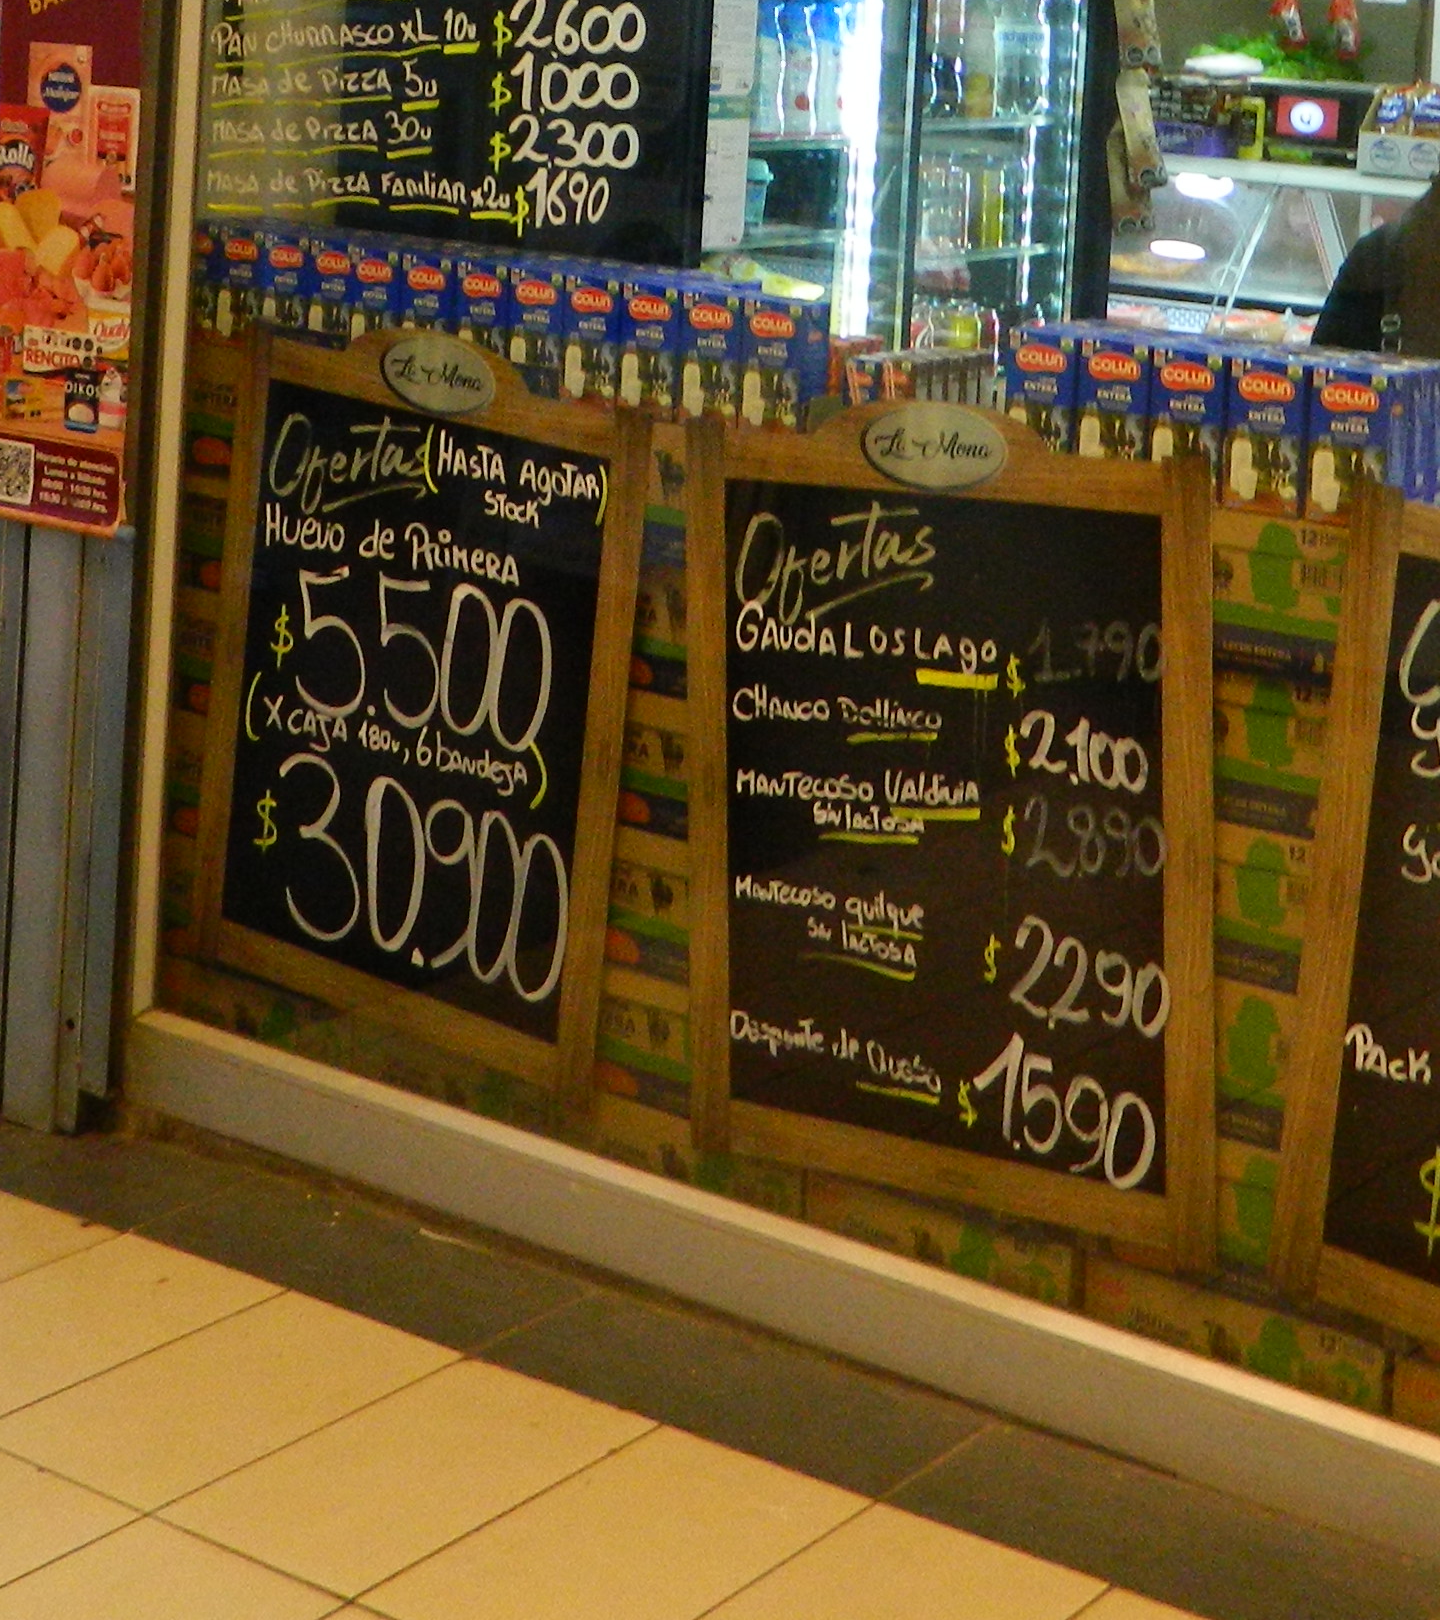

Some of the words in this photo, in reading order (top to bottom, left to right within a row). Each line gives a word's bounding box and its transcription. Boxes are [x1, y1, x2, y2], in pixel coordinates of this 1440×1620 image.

[276, 67, 309, 94] de
[271, 115, 303, 143] de
[269, 167, 298, 192] de
[913, 430, 994, 460] Mona
[358, 518, 396, 561] de
[734, 501, 938, 626] Ofertas
